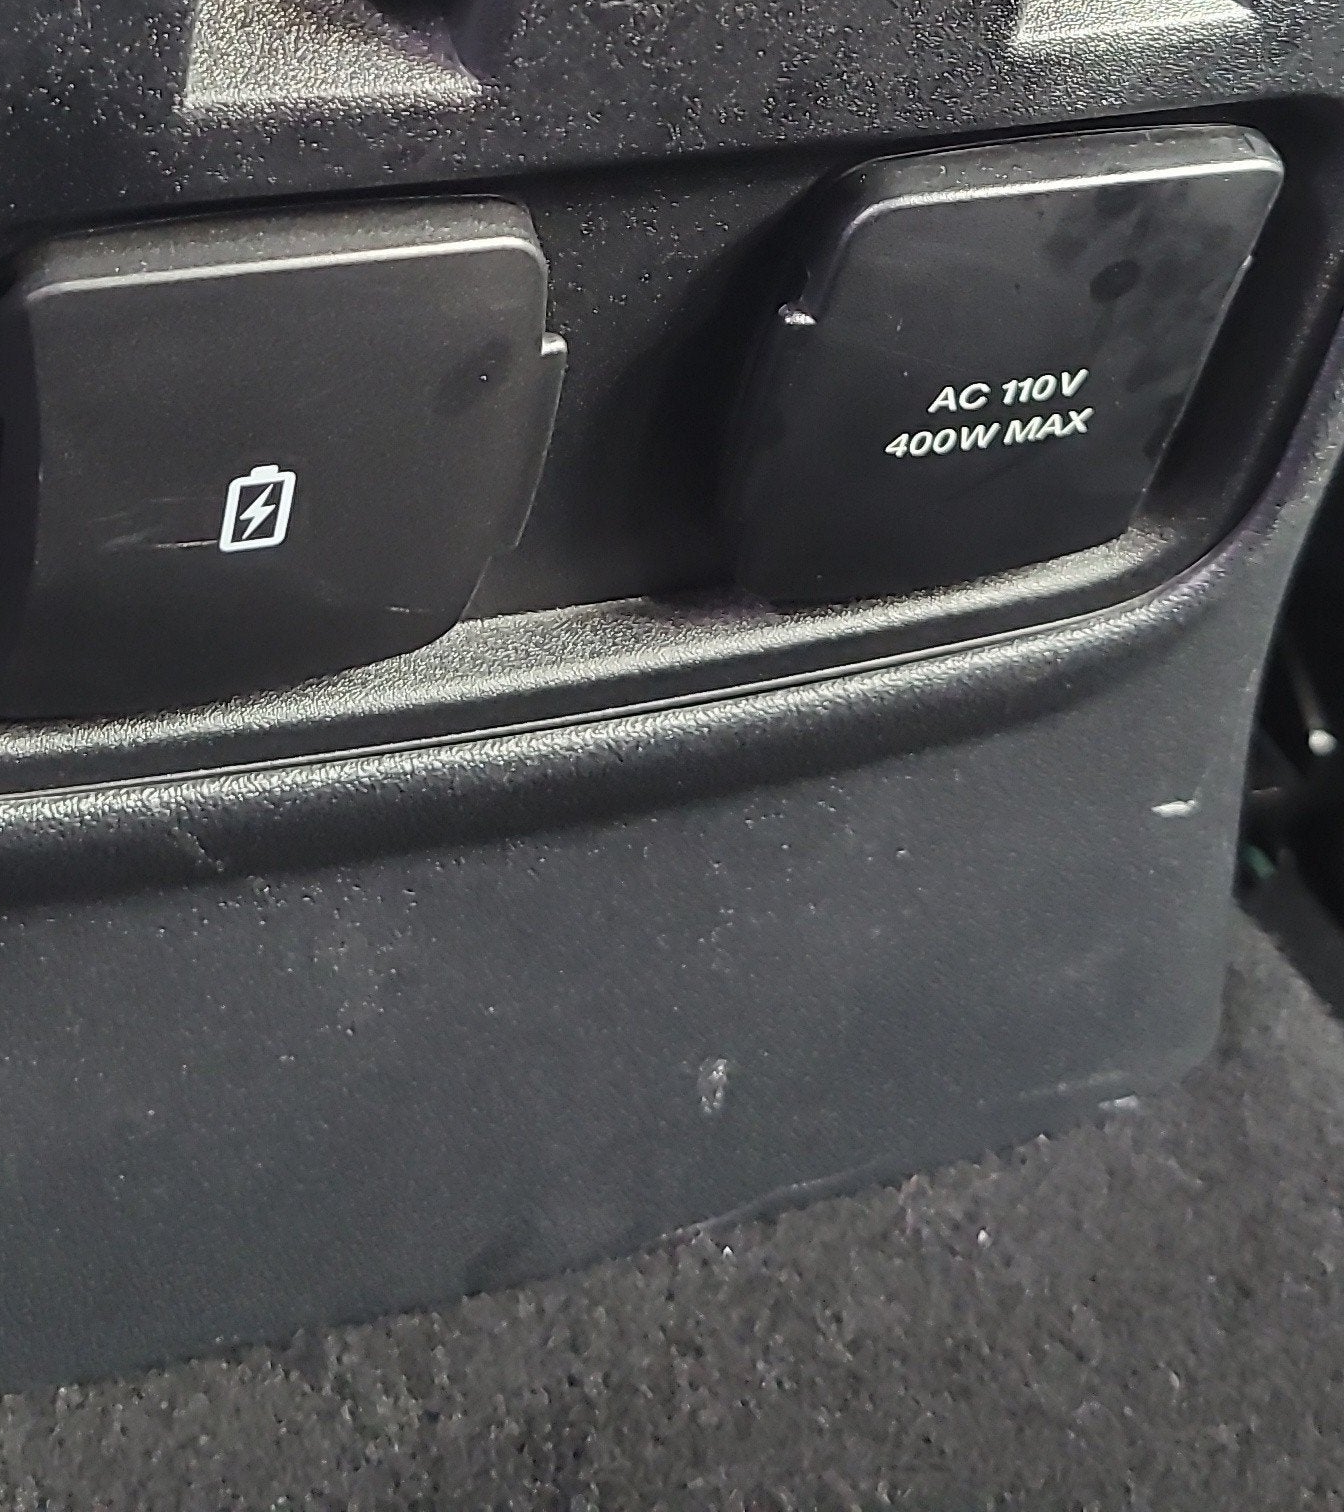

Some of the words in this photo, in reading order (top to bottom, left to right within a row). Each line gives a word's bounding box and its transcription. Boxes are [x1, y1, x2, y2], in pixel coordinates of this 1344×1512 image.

[927, 382, 992, 414] AC
[1002, 368, 1090, 406] 110V
[884, 422, 1002, 459] 400W
[1003, 407, 1094, 446] MAX
